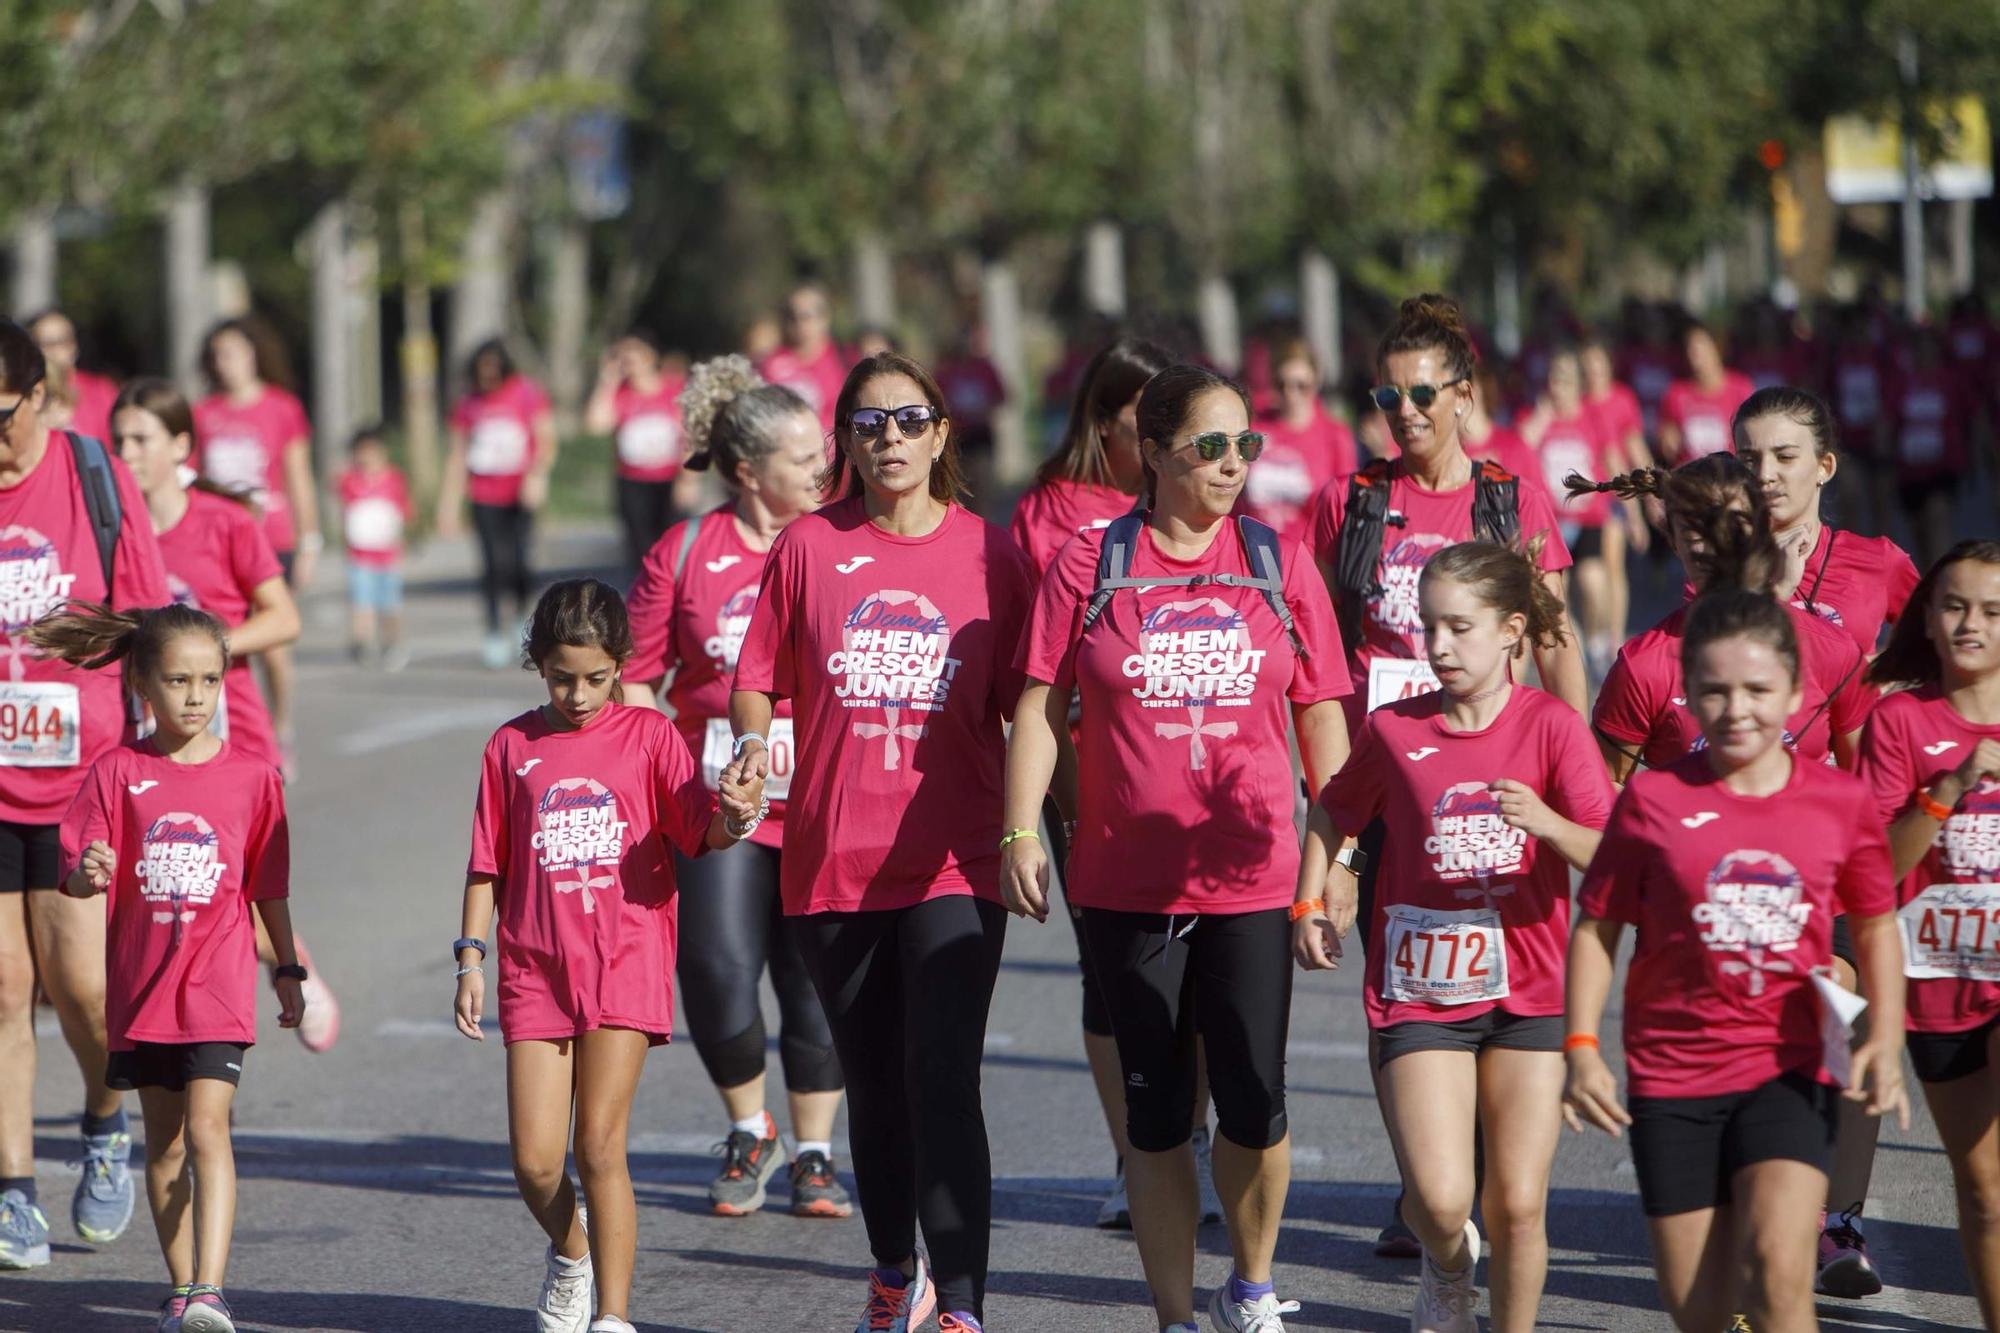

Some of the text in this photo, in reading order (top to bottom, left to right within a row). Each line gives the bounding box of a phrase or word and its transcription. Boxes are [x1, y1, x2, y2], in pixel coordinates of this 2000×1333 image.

[851, 628, 940, 657] #HEM
[1149, 629, 1239, 653] #HEM
[827, 650, 962, 682] CRESCUT
[1122, 650, 1266, 678] CRESCUT
[834, 674, 950, 703] JUNTES
[1132, 673, 1257, 699] JUNTES
[842, 699, 877, 708] cursa
[1142, 699, 1180, 708] cursa
[545, 806, 608, 828] #HEM
[531, 821, 628, 850] CRESCUT
[1424, 828, 1527, 854] CRESCUT
[148, 841, 211, 863] #HEM
[539, 839, 622, 866] JUNTES
[1432, 845, 1523, 872] JUNTES
[135, 859, 227, 881] CRESCUT
[140, 876, 218, 897] JUNTES
[1395, 929, 1489, 980] 4772
